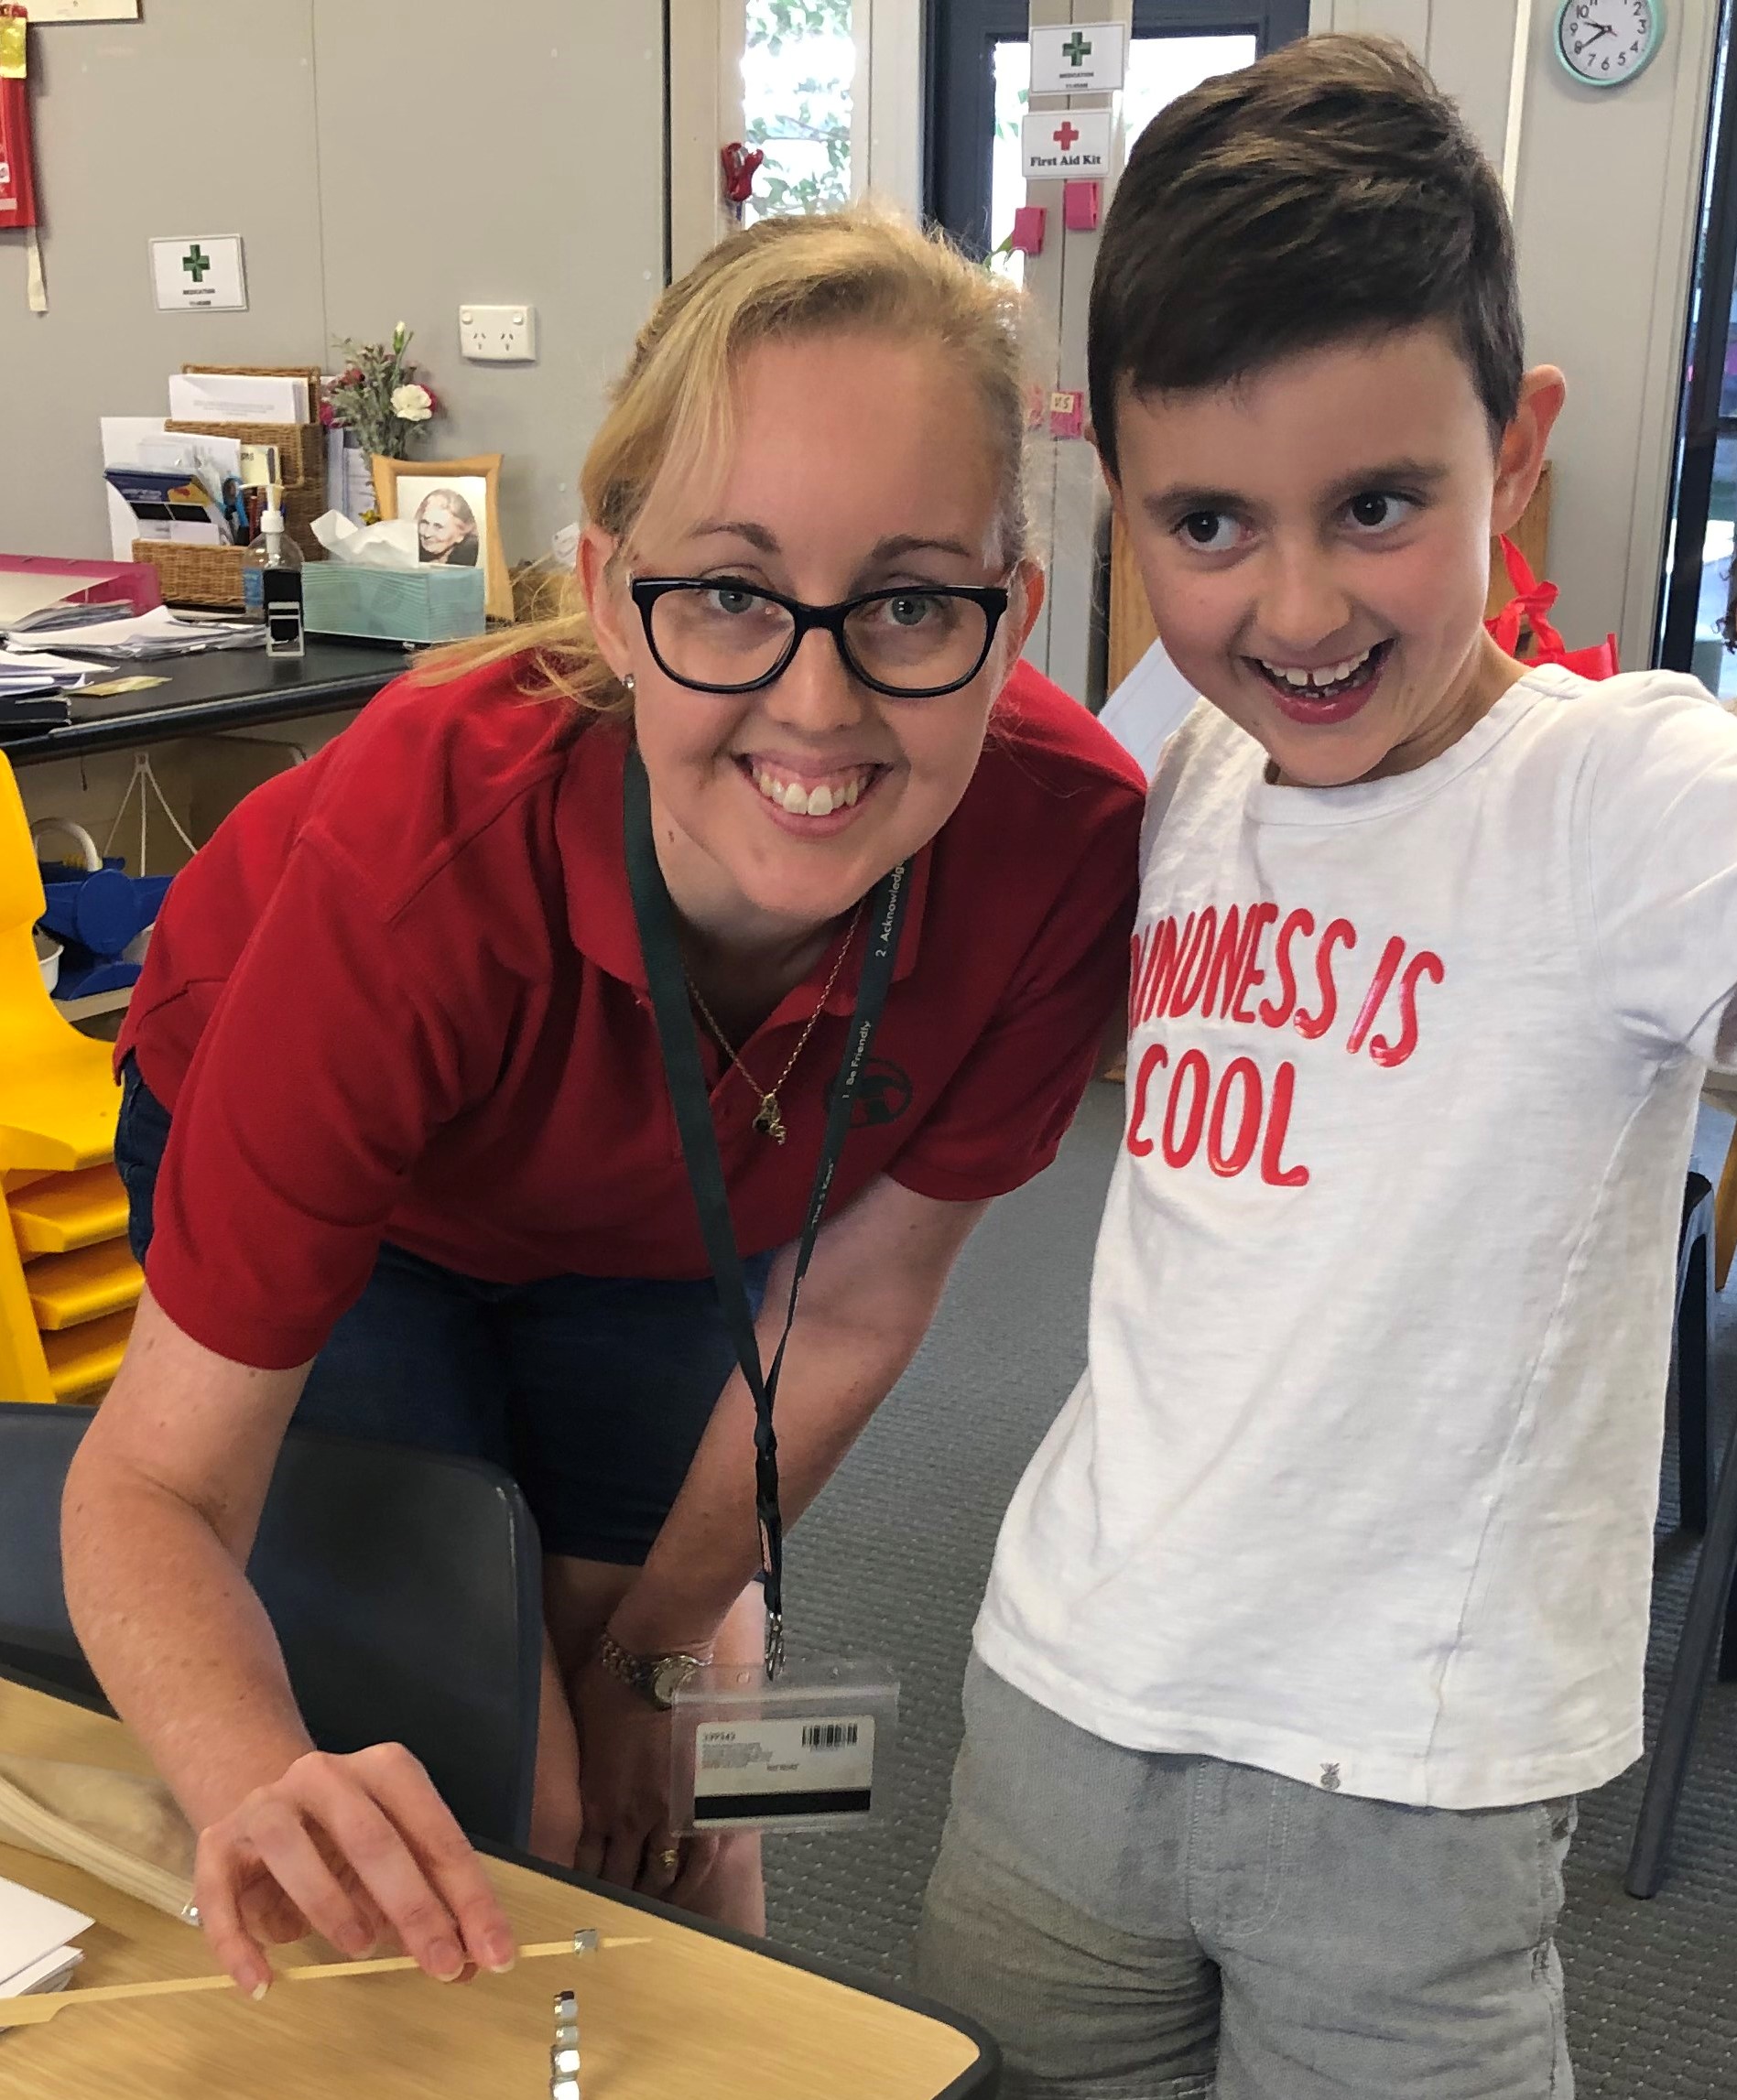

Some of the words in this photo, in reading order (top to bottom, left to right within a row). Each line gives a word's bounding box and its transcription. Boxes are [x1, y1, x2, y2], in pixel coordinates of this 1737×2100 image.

[1576, 5, 1589, 18] 10
[1634, 1, 1642, 16] 2
[1570, 22, 1578, 37] 9
[1637, 18, 1646, 34] 3
[1574, 40, 1582, 54] 8
[1630, 40, 1638, 53] 4
[1588, 53, 1596, 67] 7
[1601, 57, 1610, 70] 6
[1618, 51, 1625, 66] 5
[1030, 157, 1058, 167] First
[1060, 156, 1080, 165] Aid
[1083, 155, 1102, 165] Kit
[879, 861, 905, 942] Acknowledg
[1346, 935, 1445, 1068] IS
[850, 1020, 872, 1067] Friendly
[845, 1070, 857, 1086] Be
[1126, 1043, 1309, 1186] COOL
